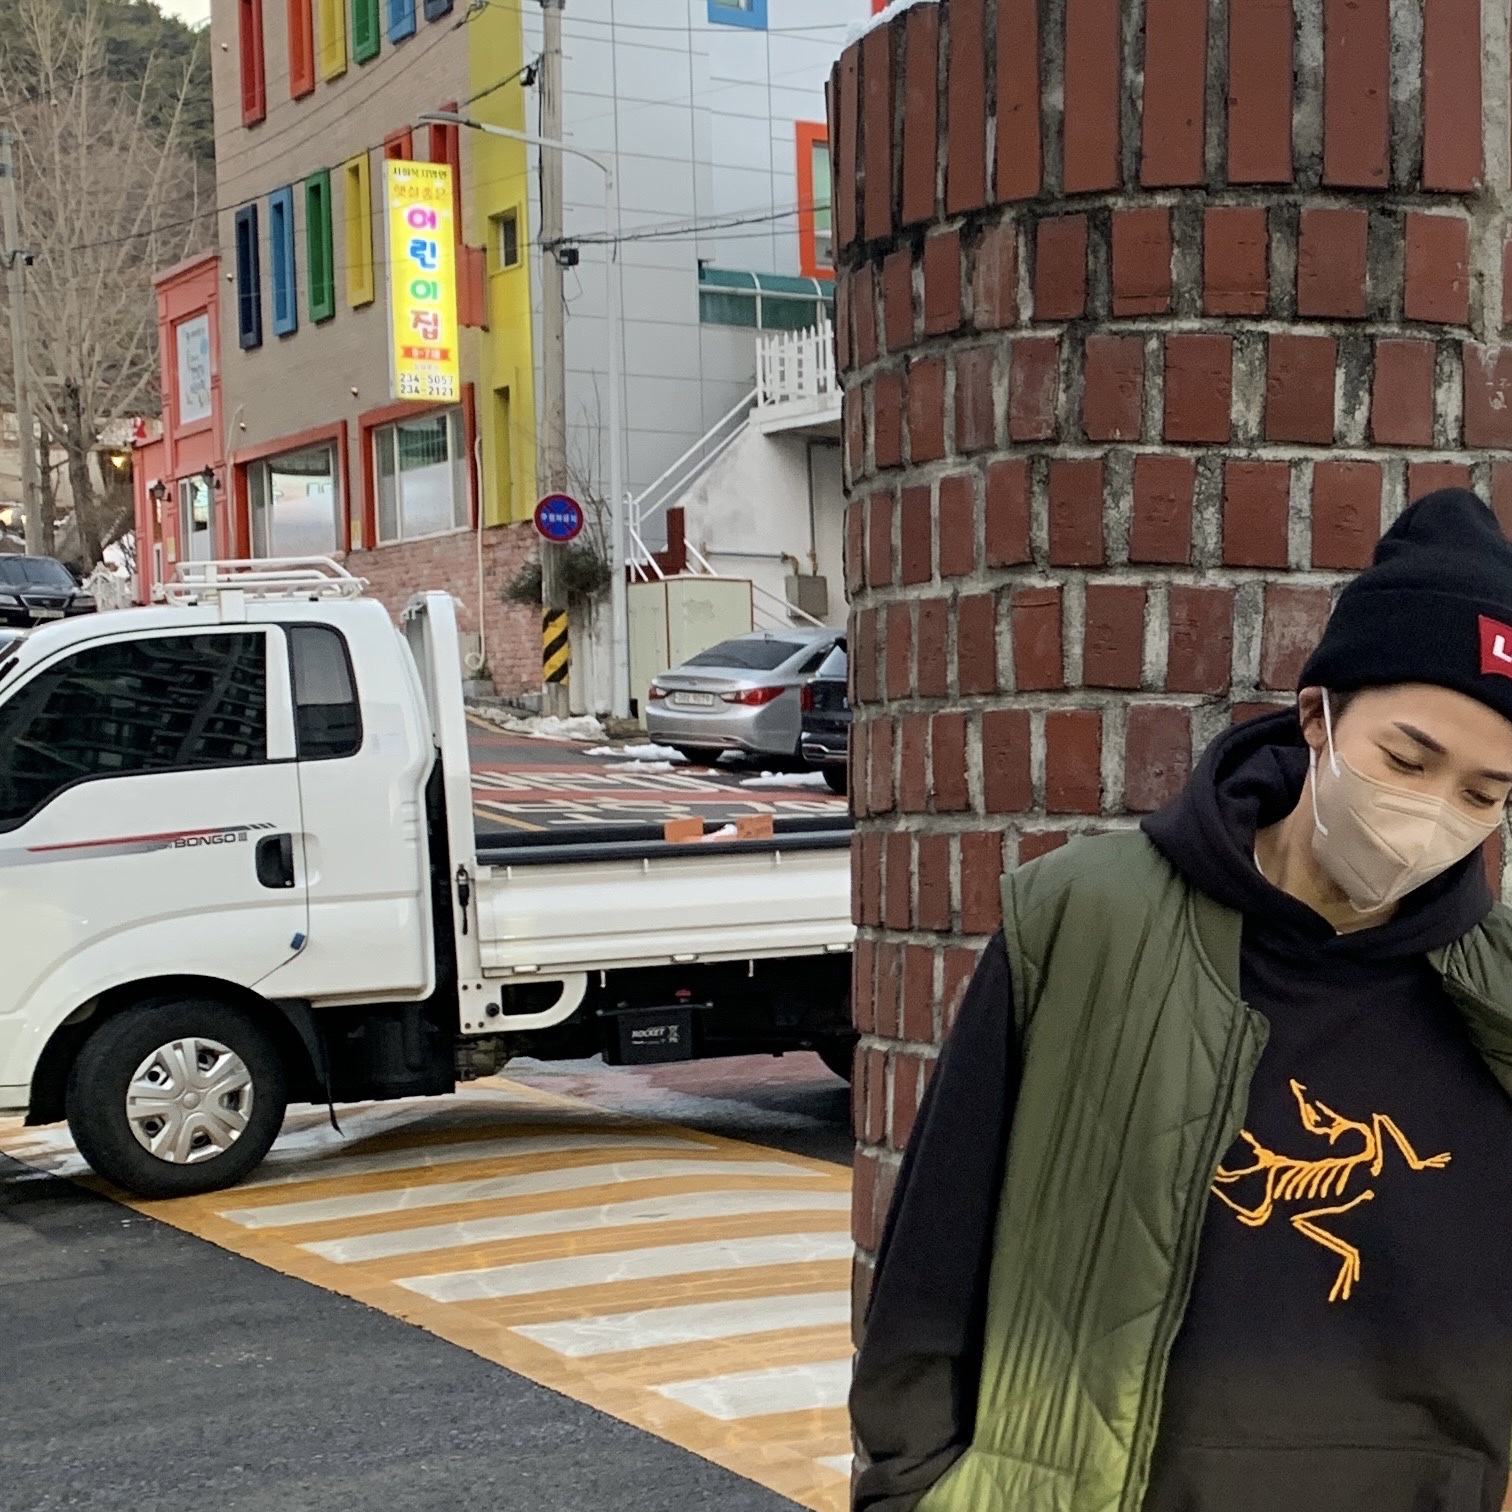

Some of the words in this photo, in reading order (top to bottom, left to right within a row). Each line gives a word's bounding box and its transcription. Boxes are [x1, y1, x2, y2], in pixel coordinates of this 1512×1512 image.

[407, 207, 439, 340] 어린이집
[400, 373, 454, 385] 234-5057
[400, 385, 454, 397] 234-2121
[174, 833, 237, 849] BONGO
